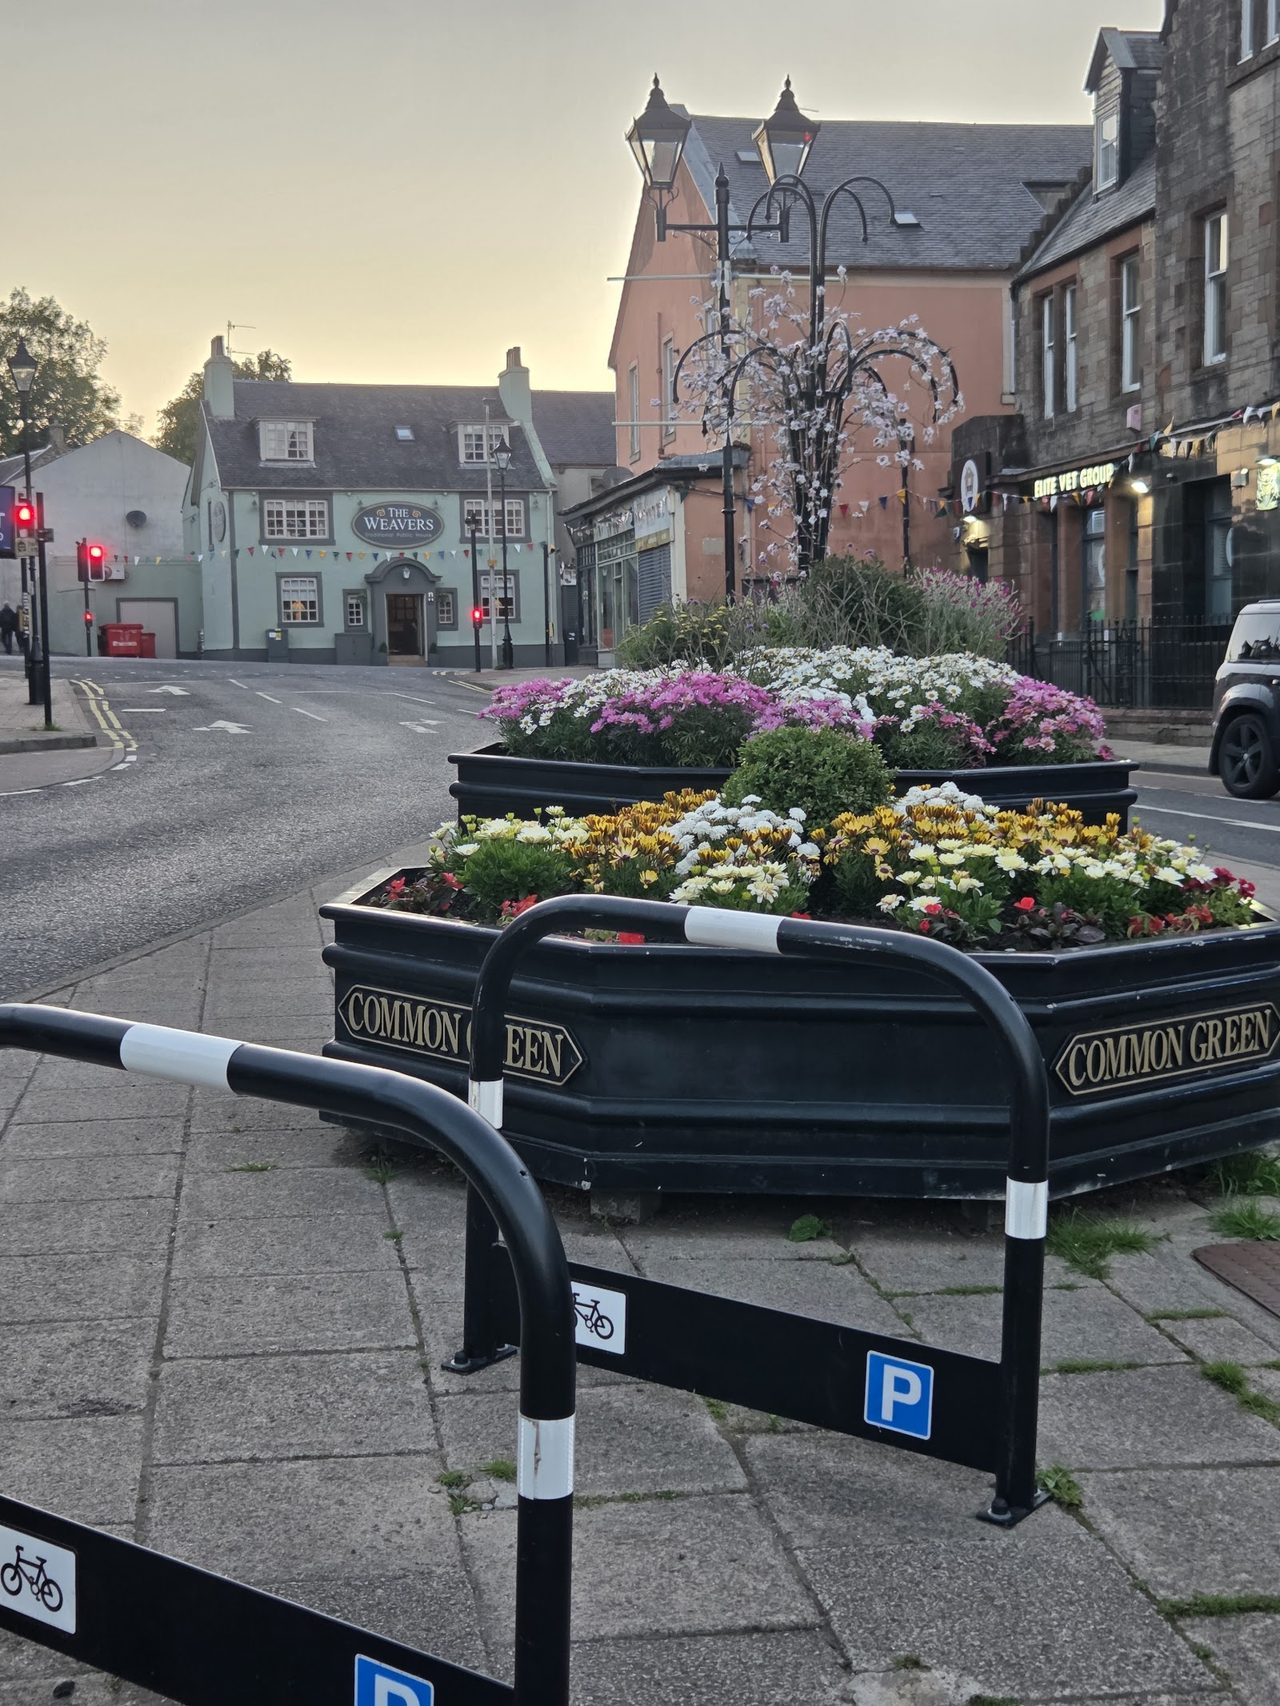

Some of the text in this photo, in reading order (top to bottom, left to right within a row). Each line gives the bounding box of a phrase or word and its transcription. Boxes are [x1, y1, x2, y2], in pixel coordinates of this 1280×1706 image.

[1034, 462, 1115, 498] ELITE VET GROUP
[363, 516, 434, 531] WEAVERS
[388, 507, 410, 518] THE
[348, 992, 462, 1054] COMMON
[1068, 1008, 1272, 1086] COMMON GREEN
[881, 1363, 923, 1422] P
